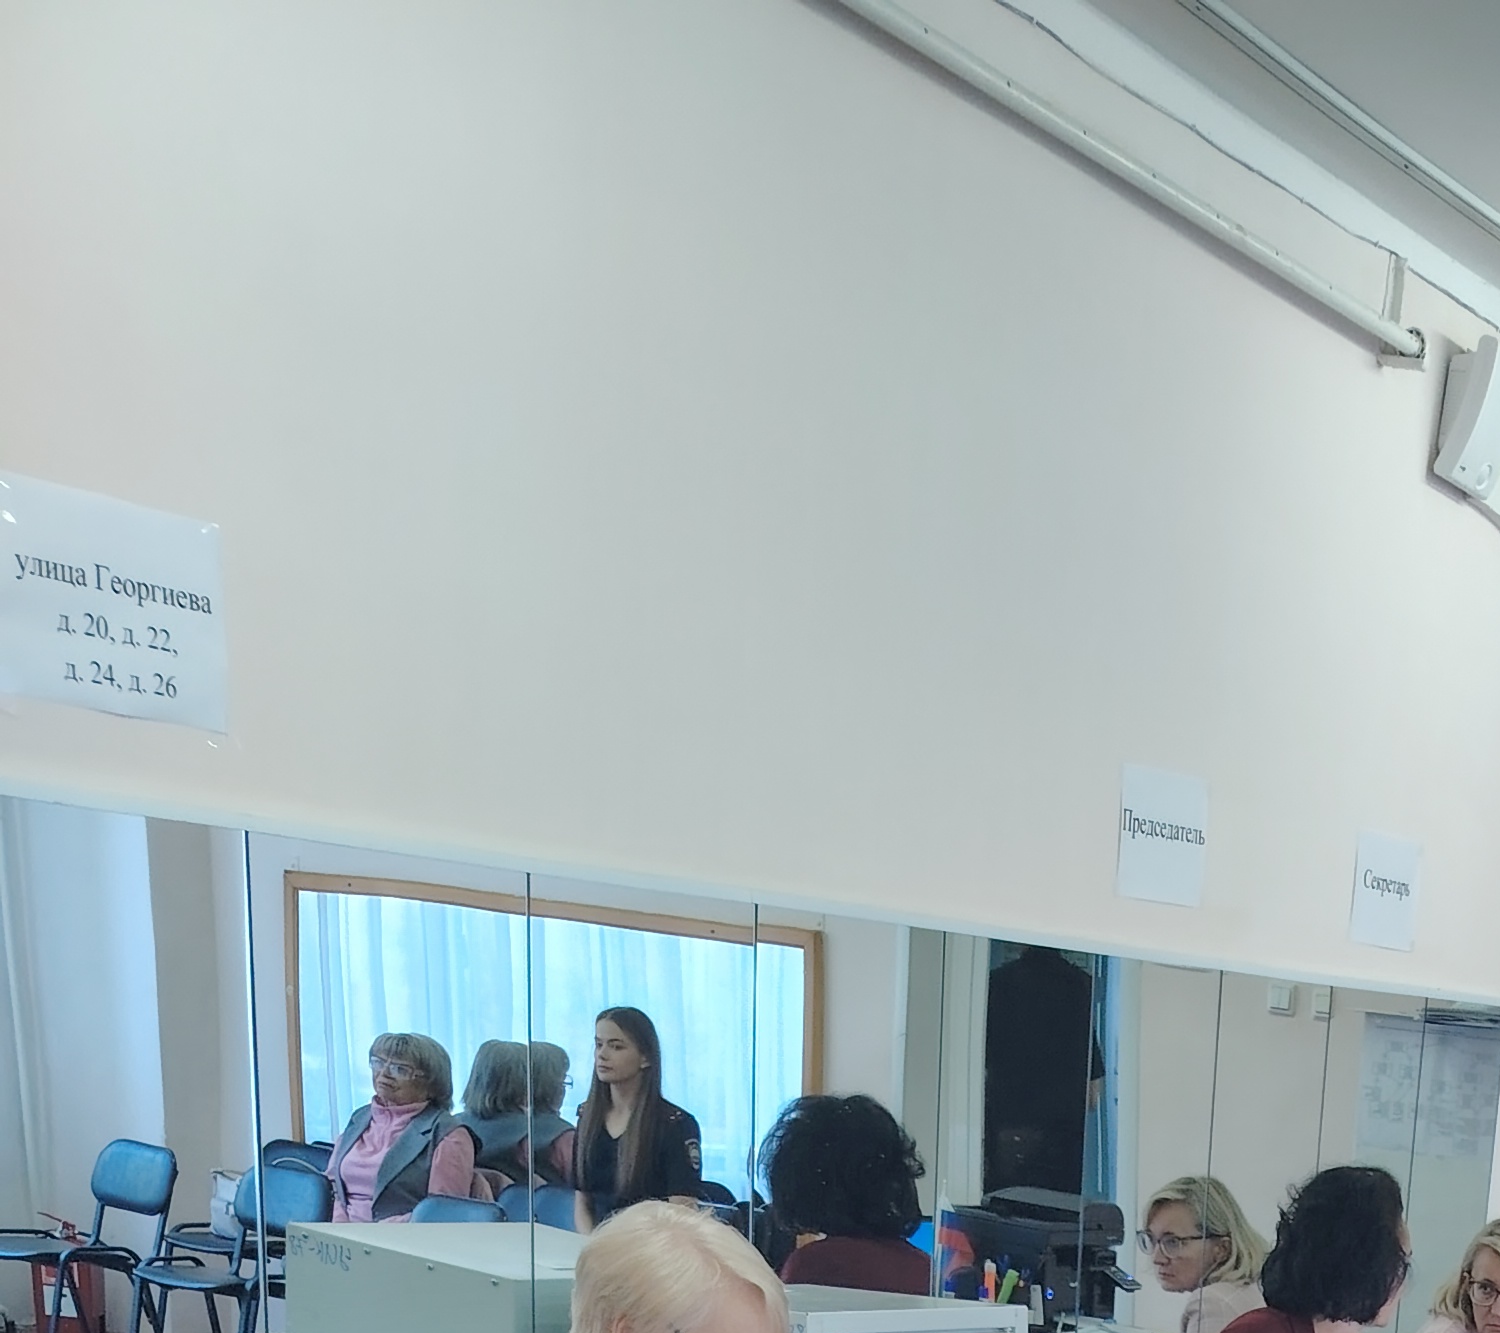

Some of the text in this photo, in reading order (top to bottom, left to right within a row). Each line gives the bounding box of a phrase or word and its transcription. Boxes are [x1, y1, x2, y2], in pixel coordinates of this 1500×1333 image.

[14, 553, 213, 615] улица Георгиева
[57, 613, 179, 656] д. 20, д. 22,
[64, 660, 178, 699] д. 24, д. 26
[1122, 808, 1206, 846] Председатель
[1363, 869, 1411, 901] Секретарь
